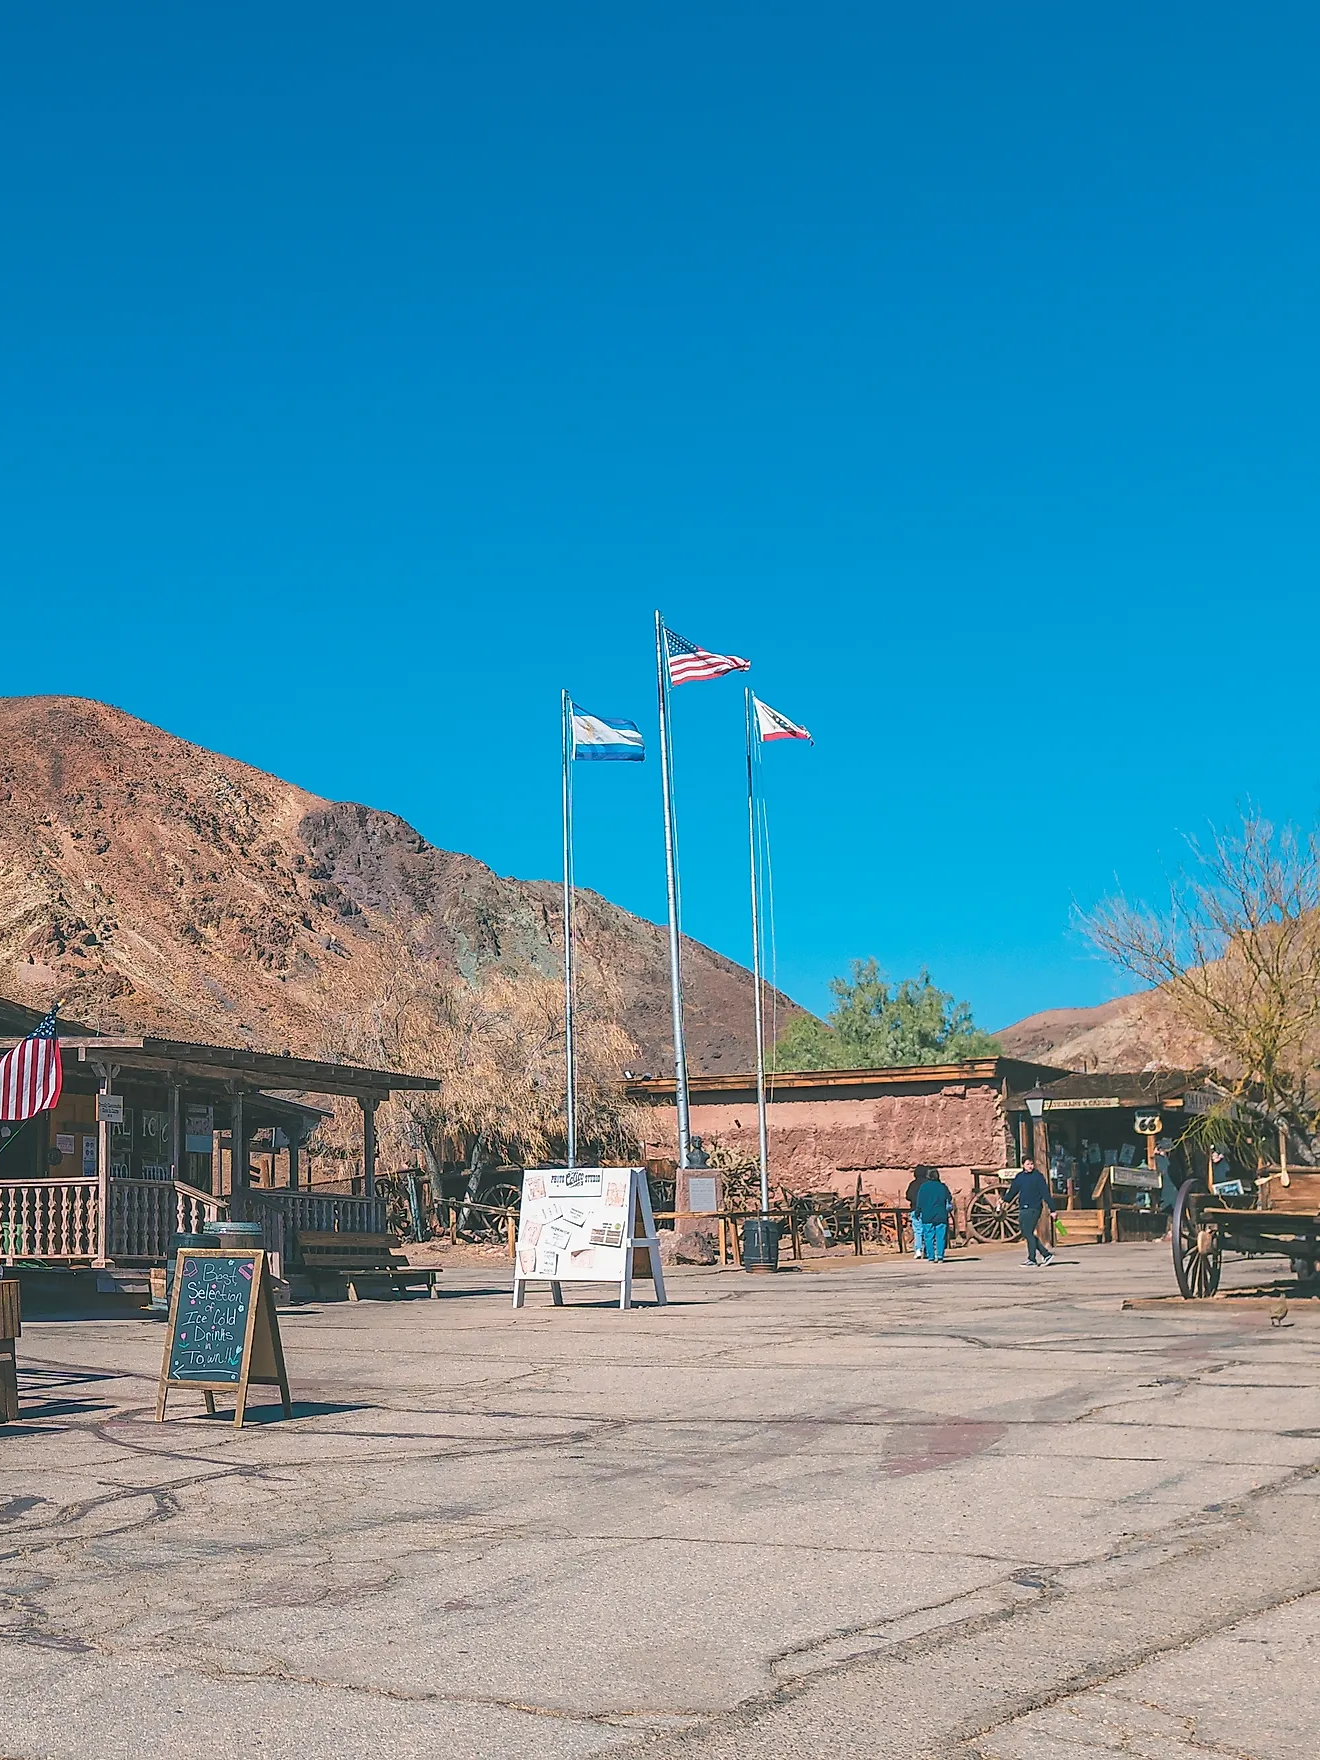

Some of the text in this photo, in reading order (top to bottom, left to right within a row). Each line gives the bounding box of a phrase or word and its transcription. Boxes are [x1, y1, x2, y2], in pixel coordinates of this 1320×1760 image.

[1139, 1117, 1156, 1131] 66
[203, 1263, 237, 1286] Best
[187, 1281, 244, 1304] Selection
[205, 1302, 215, 1313] of
[182, 1308, 236, 1326] Ice Cold
[194, 1325, 234, 1342] Drinks
